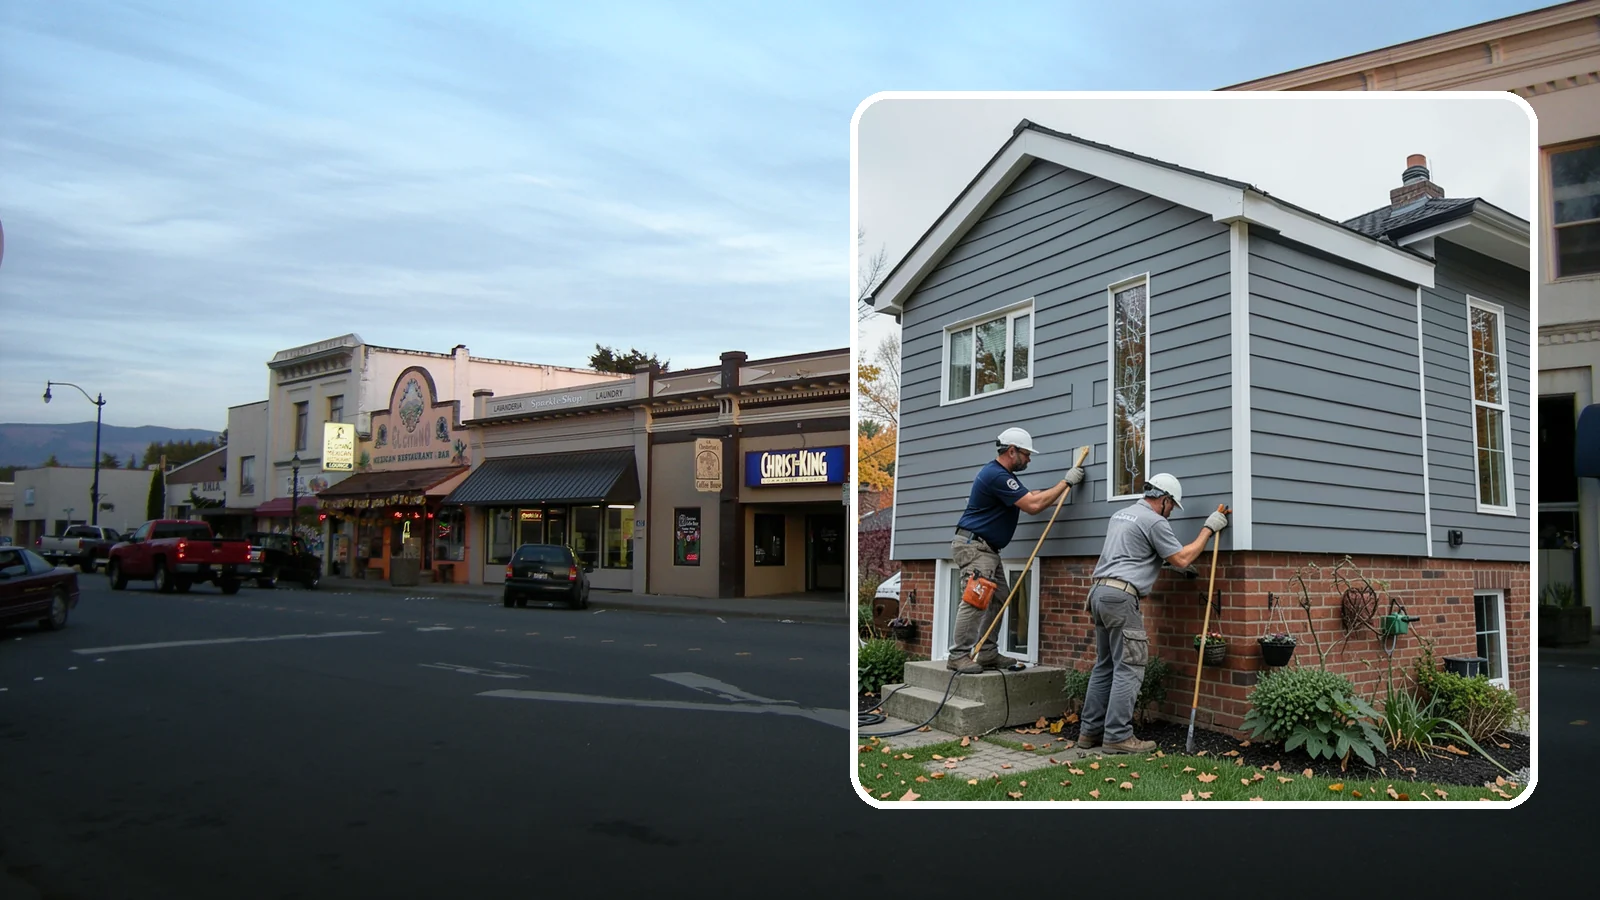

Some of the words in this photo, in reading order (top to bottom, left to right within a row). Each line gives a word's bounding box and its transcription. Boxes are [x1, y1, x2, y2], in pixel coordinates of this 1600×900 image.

[493, 402, 523, 413] LAVANDERIA
[531, 397, 561, 409] Sparkle
[562, 394, 583, 404] Shop
[595, 389, 624, 400] LAUNDRY
[373, 454, 396, 464] MEXICAN
[398, 450, 433, 462] RESTAURANT
[438, 449, 450, 459] BAR
[760, 452, 798, 478] CHRIST
[799, 449, 827, 477] KING
[696, 480, 709, 488] Coffee
